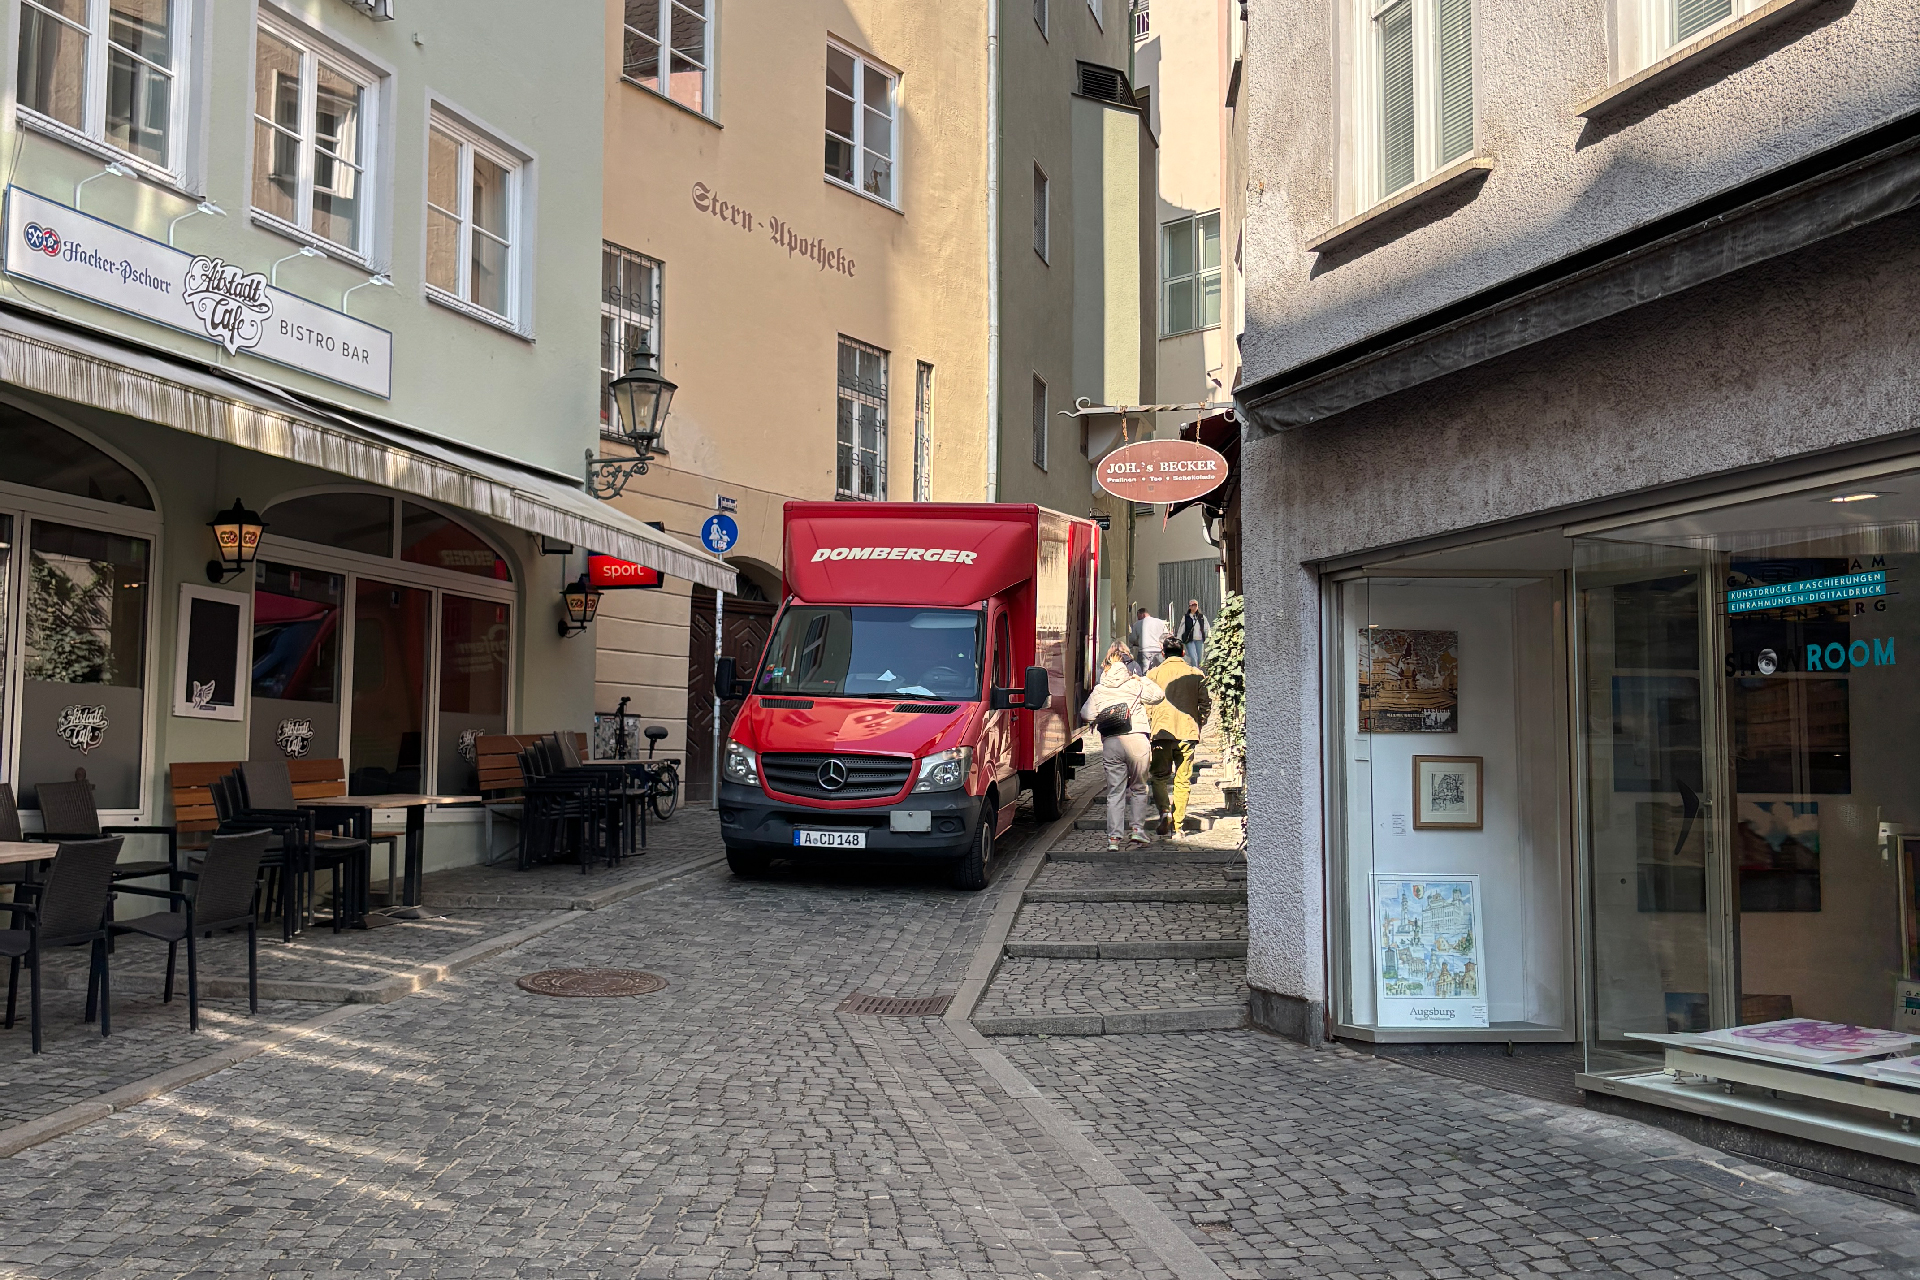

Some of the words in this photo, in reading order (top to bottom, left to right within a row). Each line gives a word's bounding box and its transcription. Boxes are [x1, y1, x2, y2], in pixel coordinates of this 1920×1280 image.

[692, 181, 753, 233] Stern
[769, 216, 856, 278] Apotheke
[62, 240, 172, 295] Hacker-Pschorr
[190, 259, 262, 303] Altstadt
[204, 297, 250, 345] Cafe
[280, 319, 335, 352] BISTRO
[342, 342, 370, 365] BAR
[1159, 461, 1217, 472] BECKER
[810, 547, 978, 565] DOMBERGER
[1850, 555, 1886, 571] AM
[603, 563, 645, 580] sport
[1730, 584, 1793, 600] KUNSTDRUCKE
[1799, 572, 1882, 591] KASCHIERUNGEN
[1731, 594, 1804, 612] EINRAHMUNGEN
[1809, 584, 1882, 601] DIGITALDRUCK
[804, 833, 812, 845] A
[1409, 1007, 1456, 1018] Augsburg
